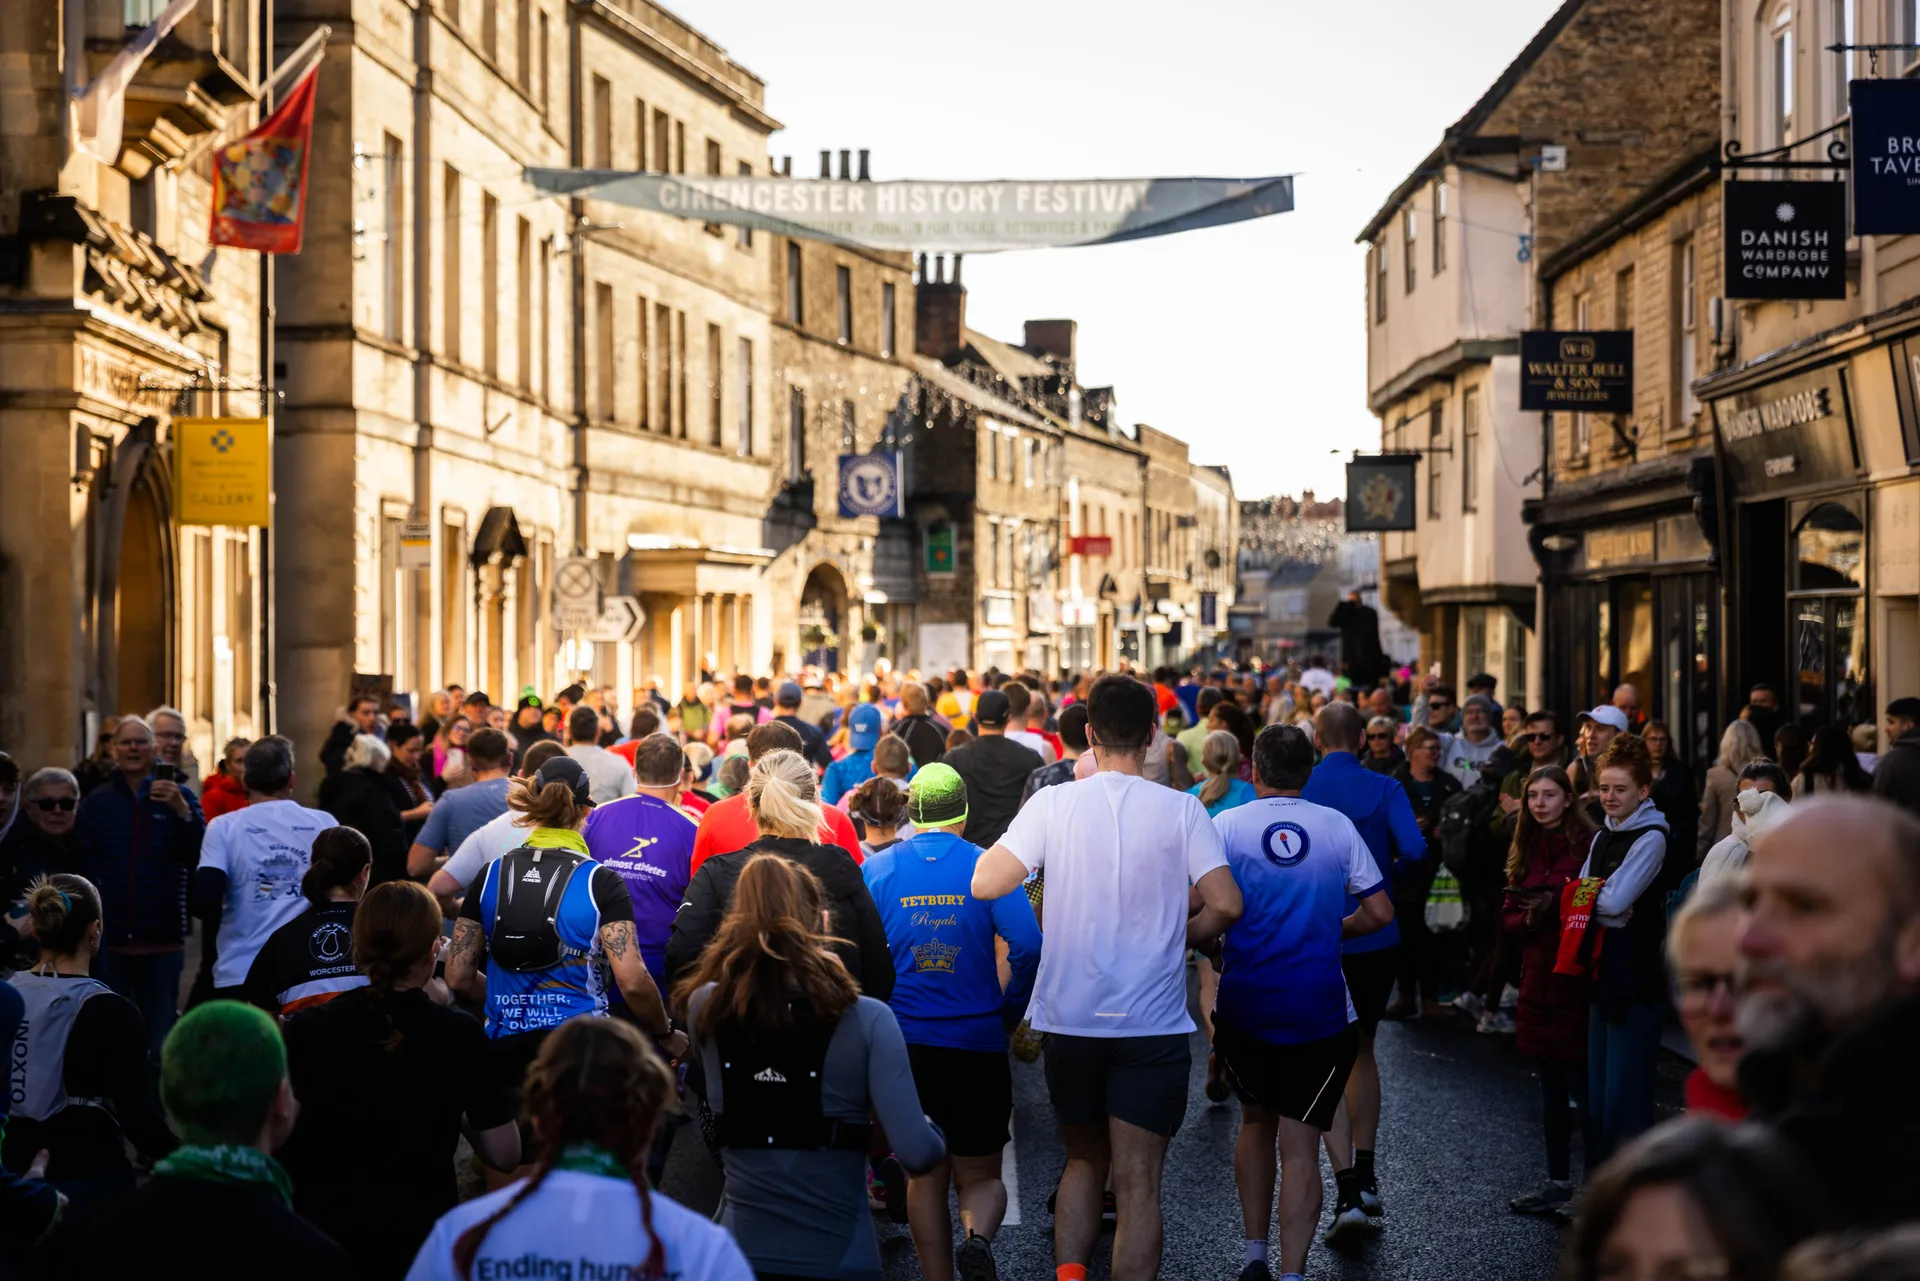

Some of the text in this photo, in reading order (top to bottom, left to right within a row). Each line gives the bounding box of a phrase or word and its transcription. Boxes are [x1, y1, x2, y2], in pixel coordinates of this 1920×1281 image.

[659, 182, 1156, 214] CIRENCESTER HISTORY FESTIVAL
[1740, 230, 1829, 246] DANISH
[1741, 249, 1829, 261] WARDROBE
[1742, 264, 1829, 279] COMPANY
[1527, 361, 1625, 378] WALTER BULL
[1553, 377, 1601, 391] & SON
[633, 862, 668, 878] athletes
[899, 894, 966, 909] TETBURY
[910, 910, 957, 932] Royals
[308, 964, 357, 977] WORCESTER
[494, 994, 571, 1006] TOGETHER,
[502, 1006, 563, 1019] WE WILL
[477, 1252, 573, 1281] Ending
